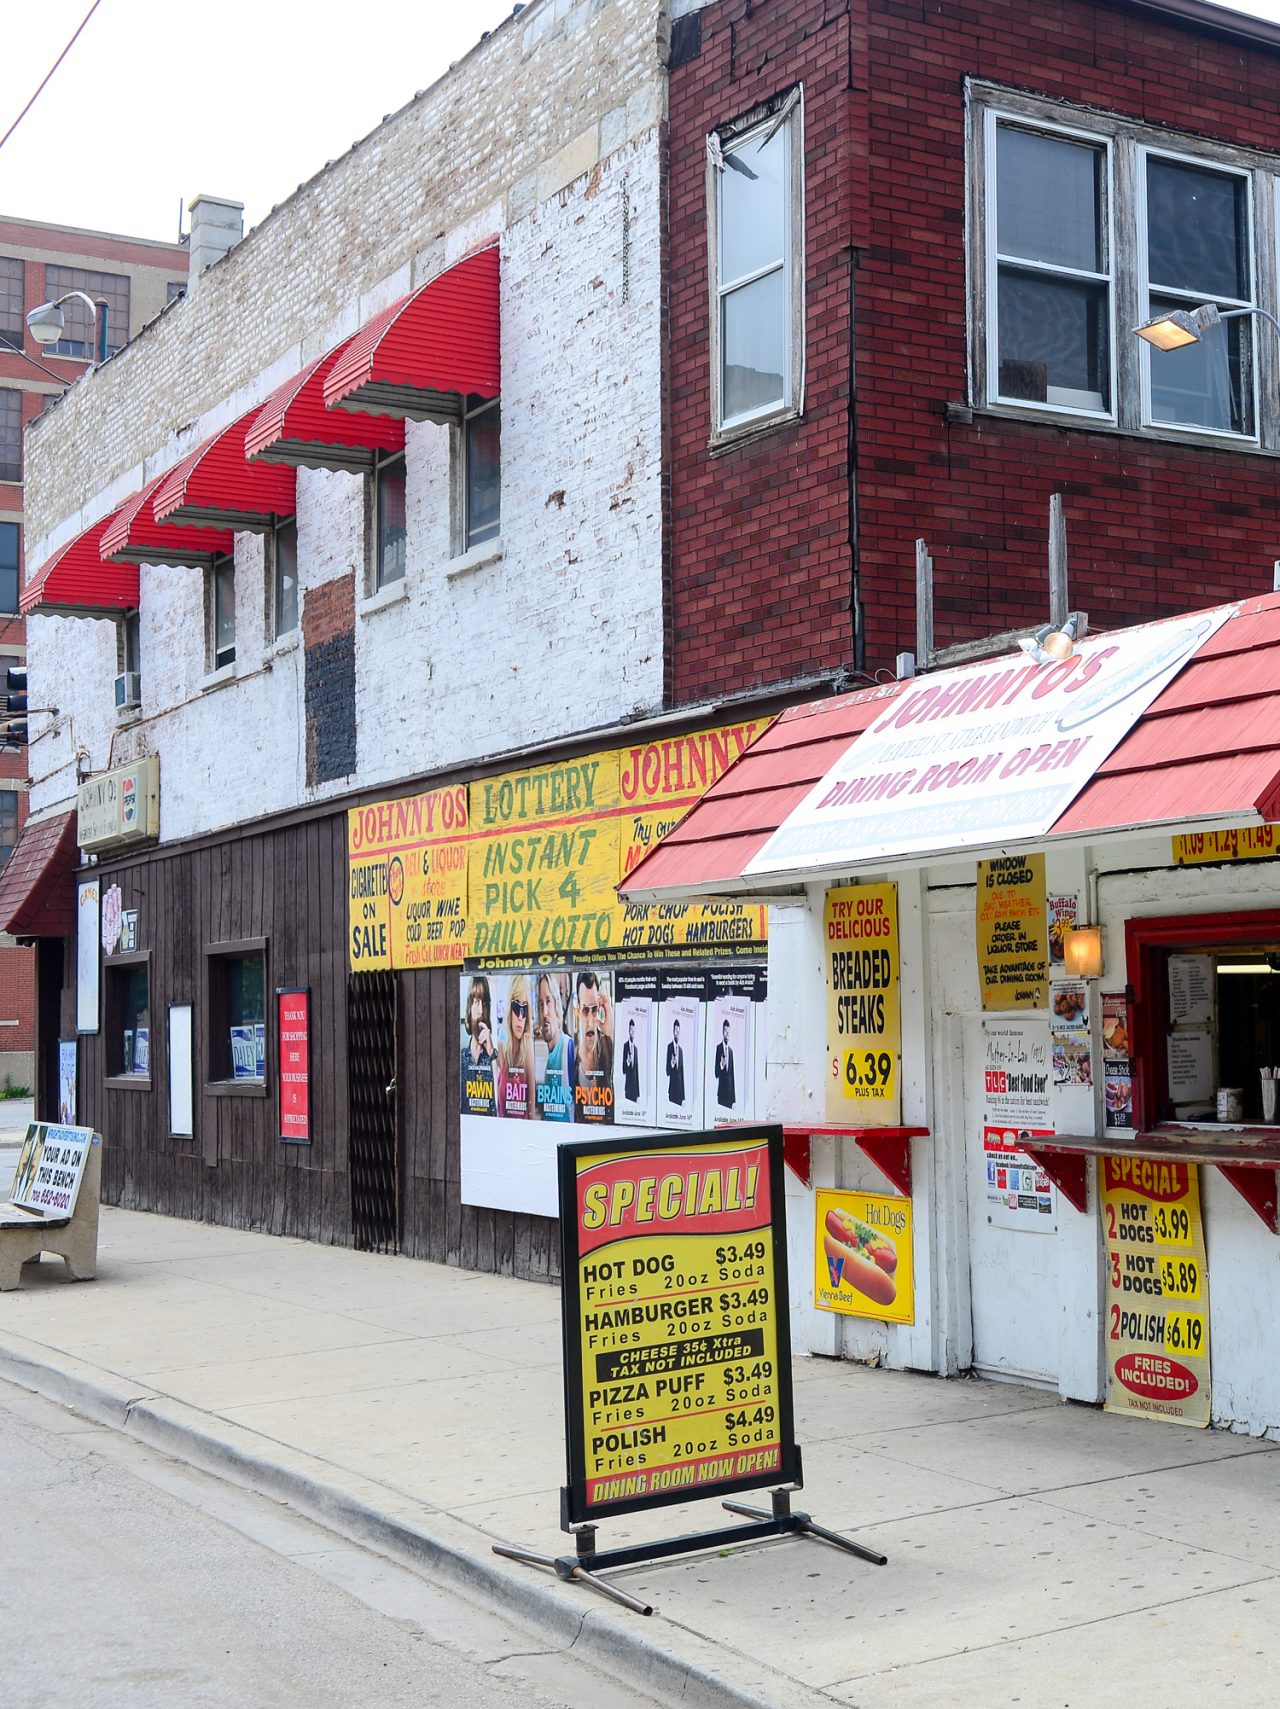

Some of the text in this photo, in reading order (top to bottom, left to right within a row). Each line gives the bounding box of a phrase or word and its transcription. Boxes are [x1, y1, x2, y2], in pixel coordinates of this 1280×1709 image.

[815, 766, 916, 811] DINING
[909, 751, 1003, 795] ROOM
[1000, 734, 1093, 781] OPEN
[483, 761, 599, 824] LOTTERY
[483, 829, 597, 878] INSTANT
[990, 856, 1026, 872] WINDOW
[986, 869, 1033, 888] IS CLOSED
[485, 871, 580, 915] PICK 4
[1050, 898, 1076, 910] Buffalo
[363, 903, 376, 920] ON
[406, 898, 461, 922] LIQUOR WINE
[832, 898, 883, 918] TRY OUR
[1055, 910, 1077, 918] Wings
[406, 919, 465, 943] COLD BEER POP
[474, 913, 611, 954] DAILY LOTTO
[623, 925, 644, 945] HOT
[686, 918, 753, 943] HAMBURGERS
[828, 917, 890, 940] DELICIOUS
[992, 932, 1026, 943] ORDER IN
[995, 921, 1021, 932] PLEASE
[352, 923, 386, 959] SALE
[987, 940, 1038, 955] LIQUOR STORE
[478, 955, 565, 969] Johnny O's
[572, 954, 590, 962] Proudly
[592, 953, 605, 961] Offers
[606, 952, 615, 960] You
[627, 951, 645, 959] Chance
[646, 950, 652, 958] To
[665, 949, 680, 957] These
[692, 948, 713, 956] Related
[714, 947, 733, 955] Prizes.
[736, 946, 752, 954] Come
[832, 949, 890, 991] BREADED
[838, 994, 885, 1034] STEAKS
[846, 1053, 891, 1086] 6.39
[466, 1081, 492, 1098] PAWN
[506, 1084, 528, 1100] BAIT
[537, 1085, 572, 1103] BRAINS
[986, 1076, 1005, 1088] TLC
[1021, 1073, 1033, 1092] Food
[576, 1087, 612, 1106] PSYCHO
[43, 1146, 82, 1167] YOUR AD ON
[38, 1167, 75, 1189] THIS BENCH
[1111, 1157, 1181, 1193] SPECIAL
[583, 1165, 759, 1230] SPECIAL!
[866, 1204, 881, 1224] Hot
[1106, 1203, 1189, 1239] 2 HOT $3.99
[1119, 1224, 1154, 1243] DOGS
[584, 1242, 765, 1283] HOT DOG $3.49
[586, 1264, 765, 1300] Fries 20oz Soda
[819, 1288, 853, 1305] Vienna Beef
[585, 1288, 768, 1332] HAMBURGER $3.49
[611, 1346, 751, 1378] TAX NOT INCLUDED
[620, 1337, 742, 1364] CHEESE 35¢ Xtra
[1135, 1357, 1170, 1374] FRIES
[590, 1362, 772, 1408] PIZZA PUFF $3.49
[1121, 1368, 1190, 1391] INCLUDED!
[592, 1406, 774, 1455] POLISH $4.49
[593, 1449, 779, 1503] DINING ROOM NOW OPEN!
